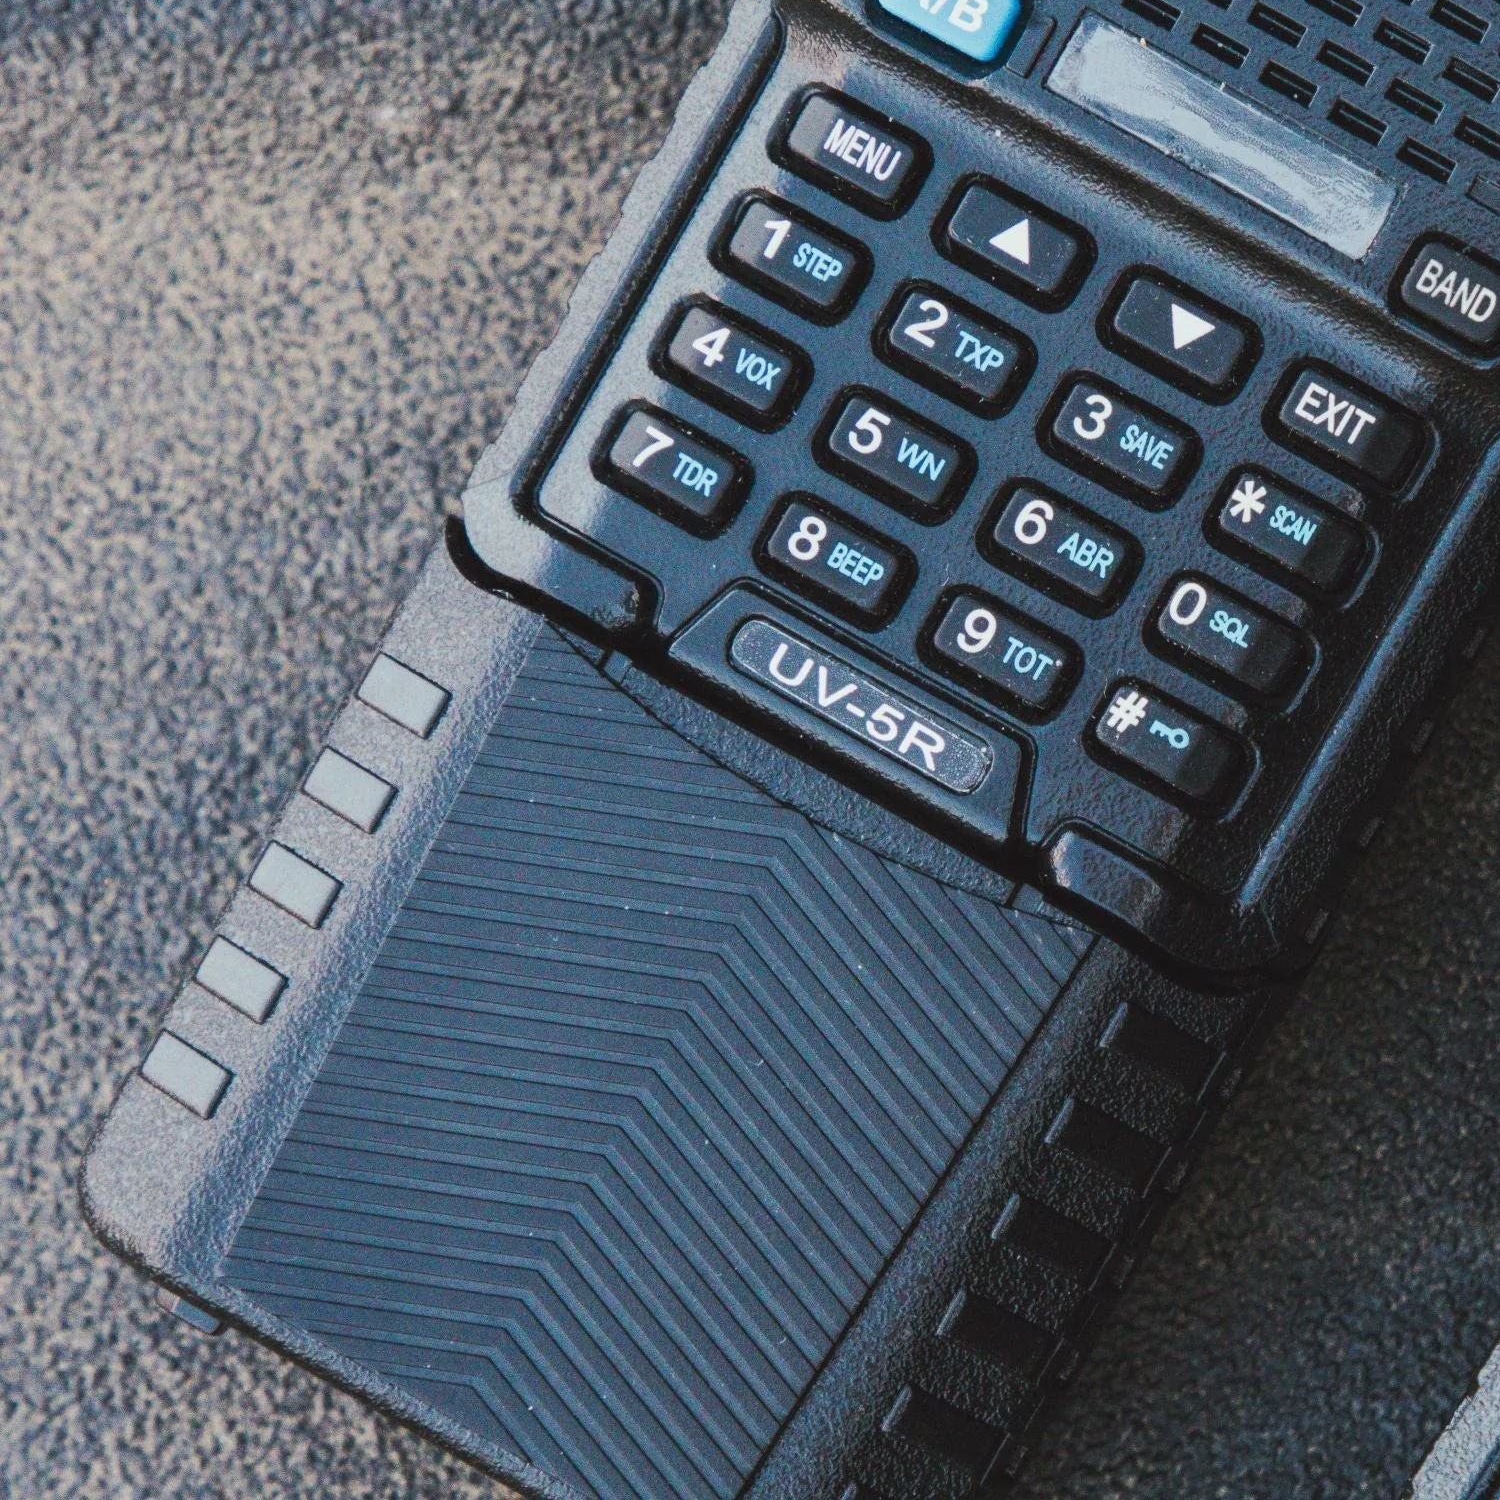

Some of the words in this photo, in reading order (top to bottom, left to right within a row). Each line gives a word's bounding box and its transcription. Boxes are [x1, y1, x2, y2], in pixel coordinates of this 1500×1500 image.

[823, 118, 902, 181] MENU
[764, 220, 791, 259] 1
[793, 243, 843, 281] STEP
[1416, 259, 1497, 323] BAND
[692, 328, 731, 366] 4
[735, 348, 781, 390] VOX
[904, 300, 948, 348] 2
[954, 330, 1004, 372] TXP
[847, 408, 891, 454] 5
[897, 438, 946, 481] WN
[1073, 394, 1112, 440] 3
[1119, 425, 1174, 470] SAVE
[1294, 382, 1376, 445] EXIT
[632, 425, 674, 467] 7
[672, 453, 718, 496] TDR
[787, 516, 827, 560] 8
[827, 542, 885, 585] BEEP
[1013, 500, 1054, 544] 6
[1057, 533, 1115, 578] ABR
[1269, 505, 1316, 546] SCAN
[956, 608, 997, 653] 9
[1002, 636, 1053, 681] TOT
[1168, 582, 1207, 625] 0
[1209, 610, 1250, 648] SQL
[768, 642, 946, 772] UV-5R
